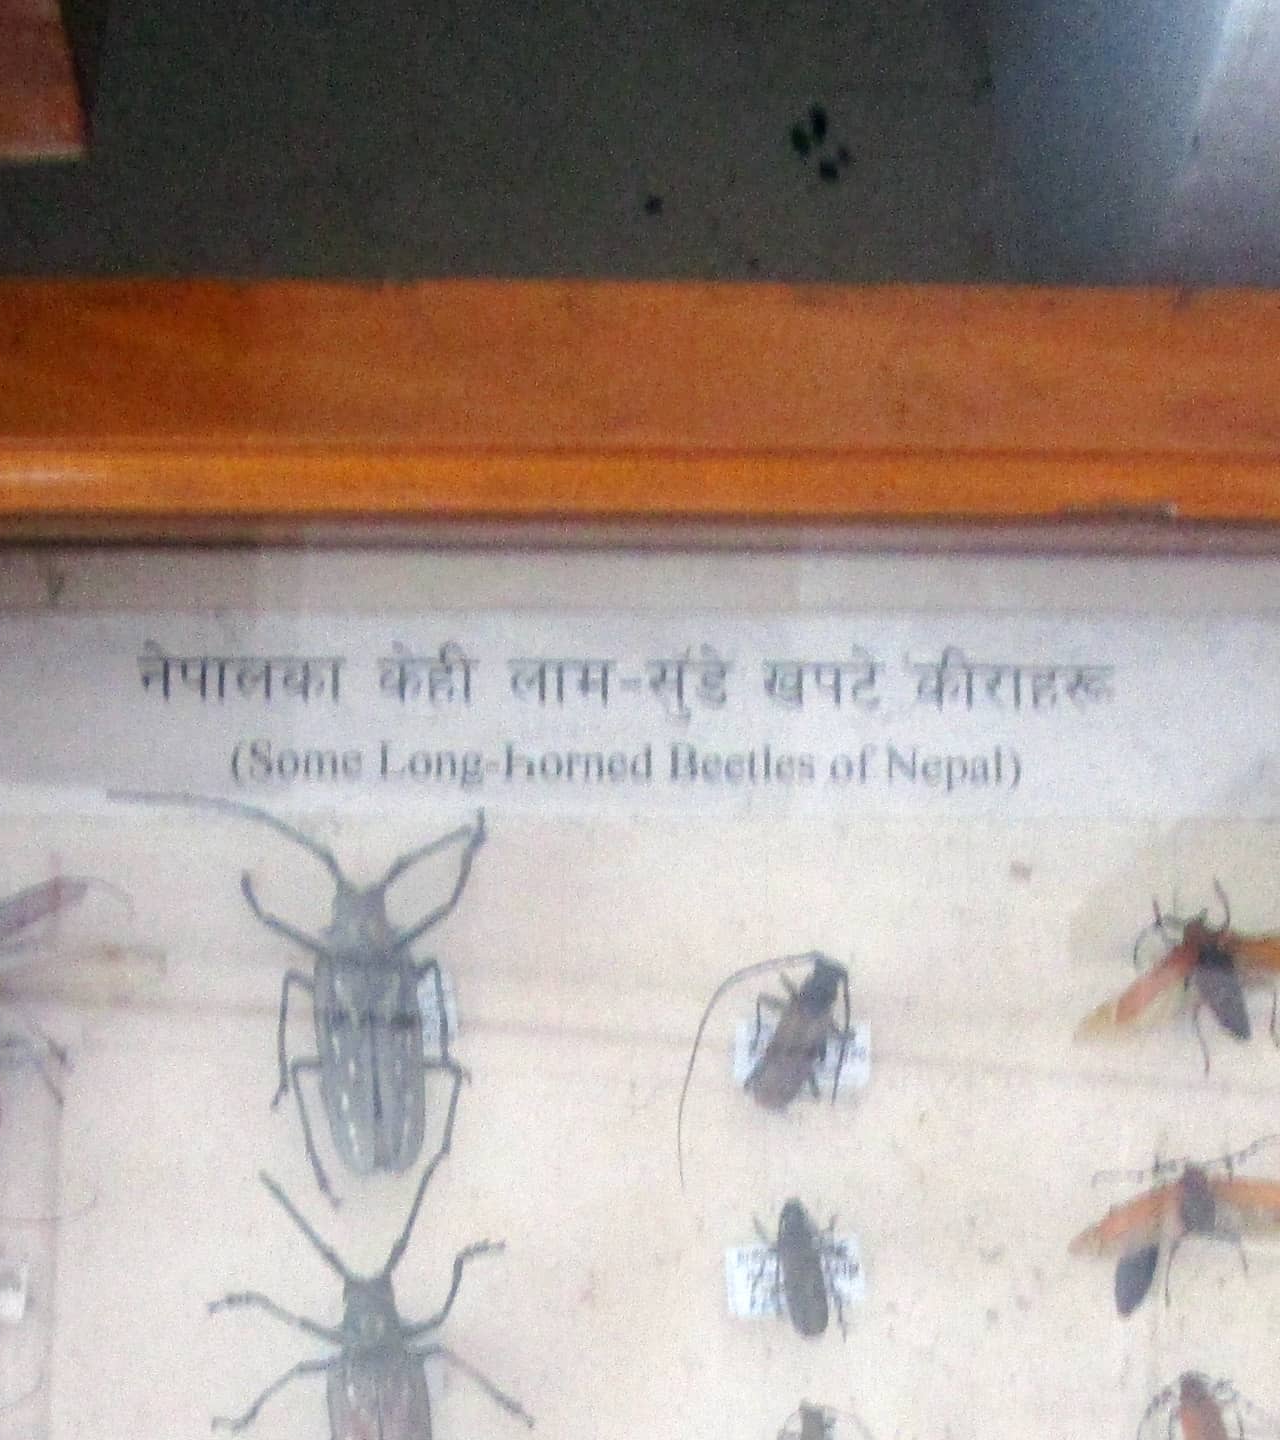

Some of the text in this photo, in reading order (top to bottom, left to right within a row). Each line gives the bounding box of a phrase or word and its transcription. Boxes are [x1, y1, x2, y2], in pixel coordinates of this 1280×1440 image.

[136, 640, 347, 702] नेपालका
[376, 640, 480, 703] केही
[762, 643, 885, 709] खपटे
[231, 740, 1022, 792] (Some Long-horned Beetles of Nepal)
